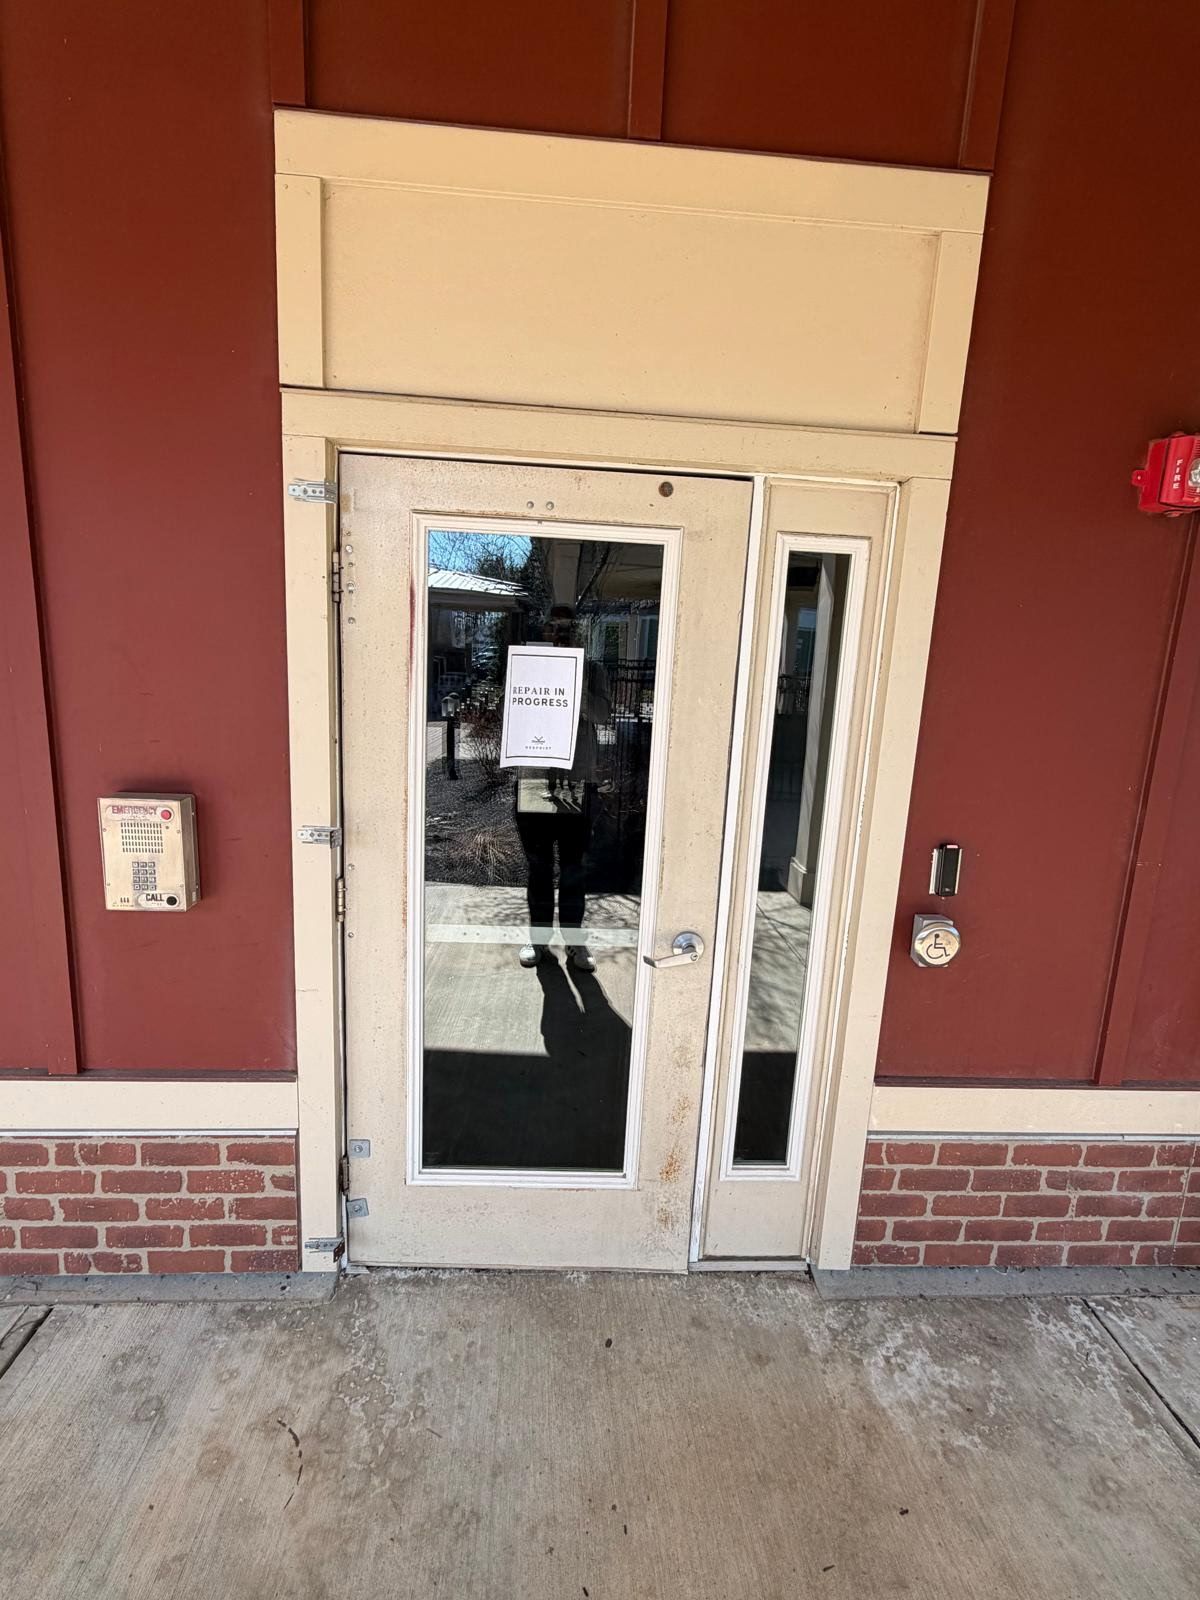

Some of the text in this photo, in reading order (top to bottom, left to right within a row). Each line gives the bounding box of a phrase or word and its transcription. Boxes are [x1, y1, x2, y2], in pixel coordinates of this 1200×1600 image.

[1172, 459, 1184, 489] FIRE
[512, 686, 565, 697] REPAIR IN
[512, 697, 568, 708] PROGRESS
[111, 805, 158, 816] EMERGENCY
[145, 893, 165, 902] CALL
